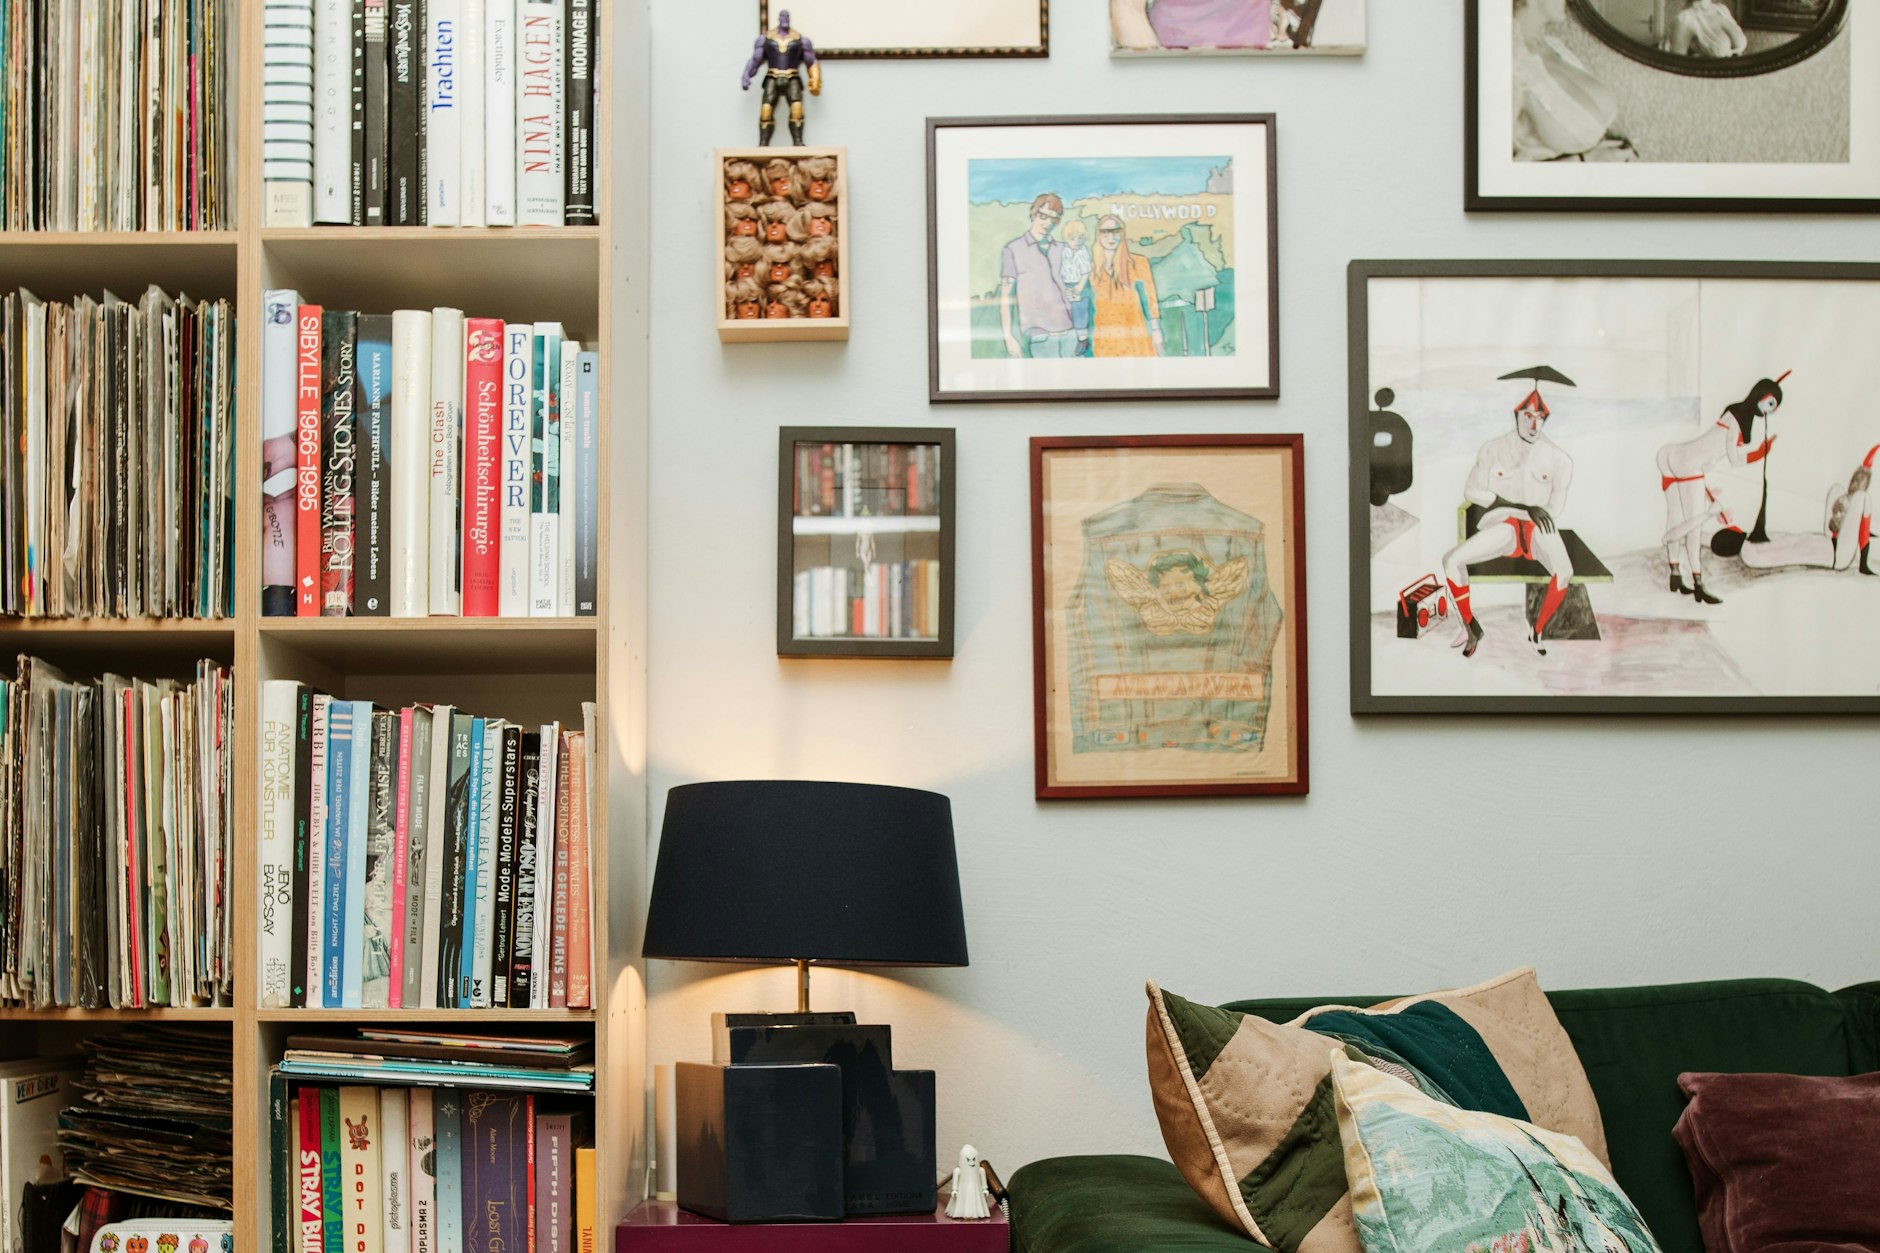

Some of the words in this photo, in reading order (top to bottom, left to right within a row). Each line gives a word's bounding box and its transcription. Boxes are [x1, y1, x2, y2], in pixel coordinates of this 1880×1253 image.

[523, 14, 552, 99] HAGEN
[571, 11, 587, 80] MOONAGE
[431, 20, 454, 114] Trachten
[524, 113, 553, 175] NINA
[580, 180, 588, 195] TEXT
[300, 316, 319, 399] SIBYLLE
[340, 340, 354, 386] STORY
[371, 352, 381, 409] MARIANNE
[329, 390, 354, 470] STONES
[432, 401, 445, 445] Clash
[444, 424, 453, 439] Bob
[507, 333, 527, 507] FOREVER
[371, 411, 381, 471] FAITHFULL
[444, 441, 453, 454] von
[432, 448, 445, 478] The
[444, 456, 453, 496] Fotografien
[475, 380, 497, 555] Schönheitschirurgie
[370, 480, 380, 509] Bilder
[329, 475, 353, 571] ROLLING
[370, 511, 379, 544] meines
[322, 528, 333, 553] BILL
[369, 546, 379, 580] Lebens
[263, 721, 277, 757] FÜR
[313, 702, 325, 772] BARBIE
[474, 742, 480, 750] 13
[278, 721, 290, 800] ANATOMIE
[336, 751, 344, 777] ZEITEN
[541, 743, 549, 787] SCHREIBER
[560, 752, 569, 788] ETHEL
[313, 783, 321, 802] IHR
[335, 778, 343, 793] DER
[416, 774, 425, 793] FILM
[472, 777, 480, 799] Styles,
[482, 745, 493, 825] TYRANNY
[571, 766, 582, 789] THE
[263, 758, 277, 841] KÜNSTLER
[334, 794, 342, 825] WANDEL
[374, 764, 393, 854] FRANÇAISE
[540, 789, 548, 805] ARNE
[313, 805, 321, 838] LEBEN
[334, 826, 341, 837] IM
[415, 806, 424, 829] MODE
[471, 811, 477, 820] du
[498, 739, 517, 902] Mode.Models.Superstars
[557, 789, 569, 845] PORTNOY
[570, 791, 582, 843] PRINCESS
[312, 851, 320, 876] IHRE
[397, 830, 405, 885] TRANSFORMED
[556, 850, 568, 869] DE
[570, 844, 580, 857] OF
[478, 836, 490, 904] BEAUTY
[518, 842, 537, 896] OSCAR
[569, 860, 580, 897] WALES
[263, 864, 276, 936] BARCSAY
[311, 880, 319, 906] WELT
[332, 882, 340, 912] DALZIEL
[411, 895, 420, 917] MODE
[555, 872, 567, 933] GEKLEDE
[410, 926, 418, 945] FILM
[499, 909, 507, 934] Lehnert
[515, 896, 535, 959] FASHION
[310, 929, 319, 952] Billy
[498, 934, 507, 959] Gertrud
[553, 936, 565, 975] MENS
[495, 975, 507, 1002] DUMONT
[17, 1079, 36, 1099] VERY
[327, 1096, 335, 1116] DAVID
[327, 1116, 335, 1143] LAPHAM
[489, 1127, 497, 1143] Alan
[488, 1143, 497, 1165] Moore
[301, 1149, 323, 1218] STRAY
[323, 1150, 344, 1217] STRAY
[419, 1200, 427, 1210] 2
